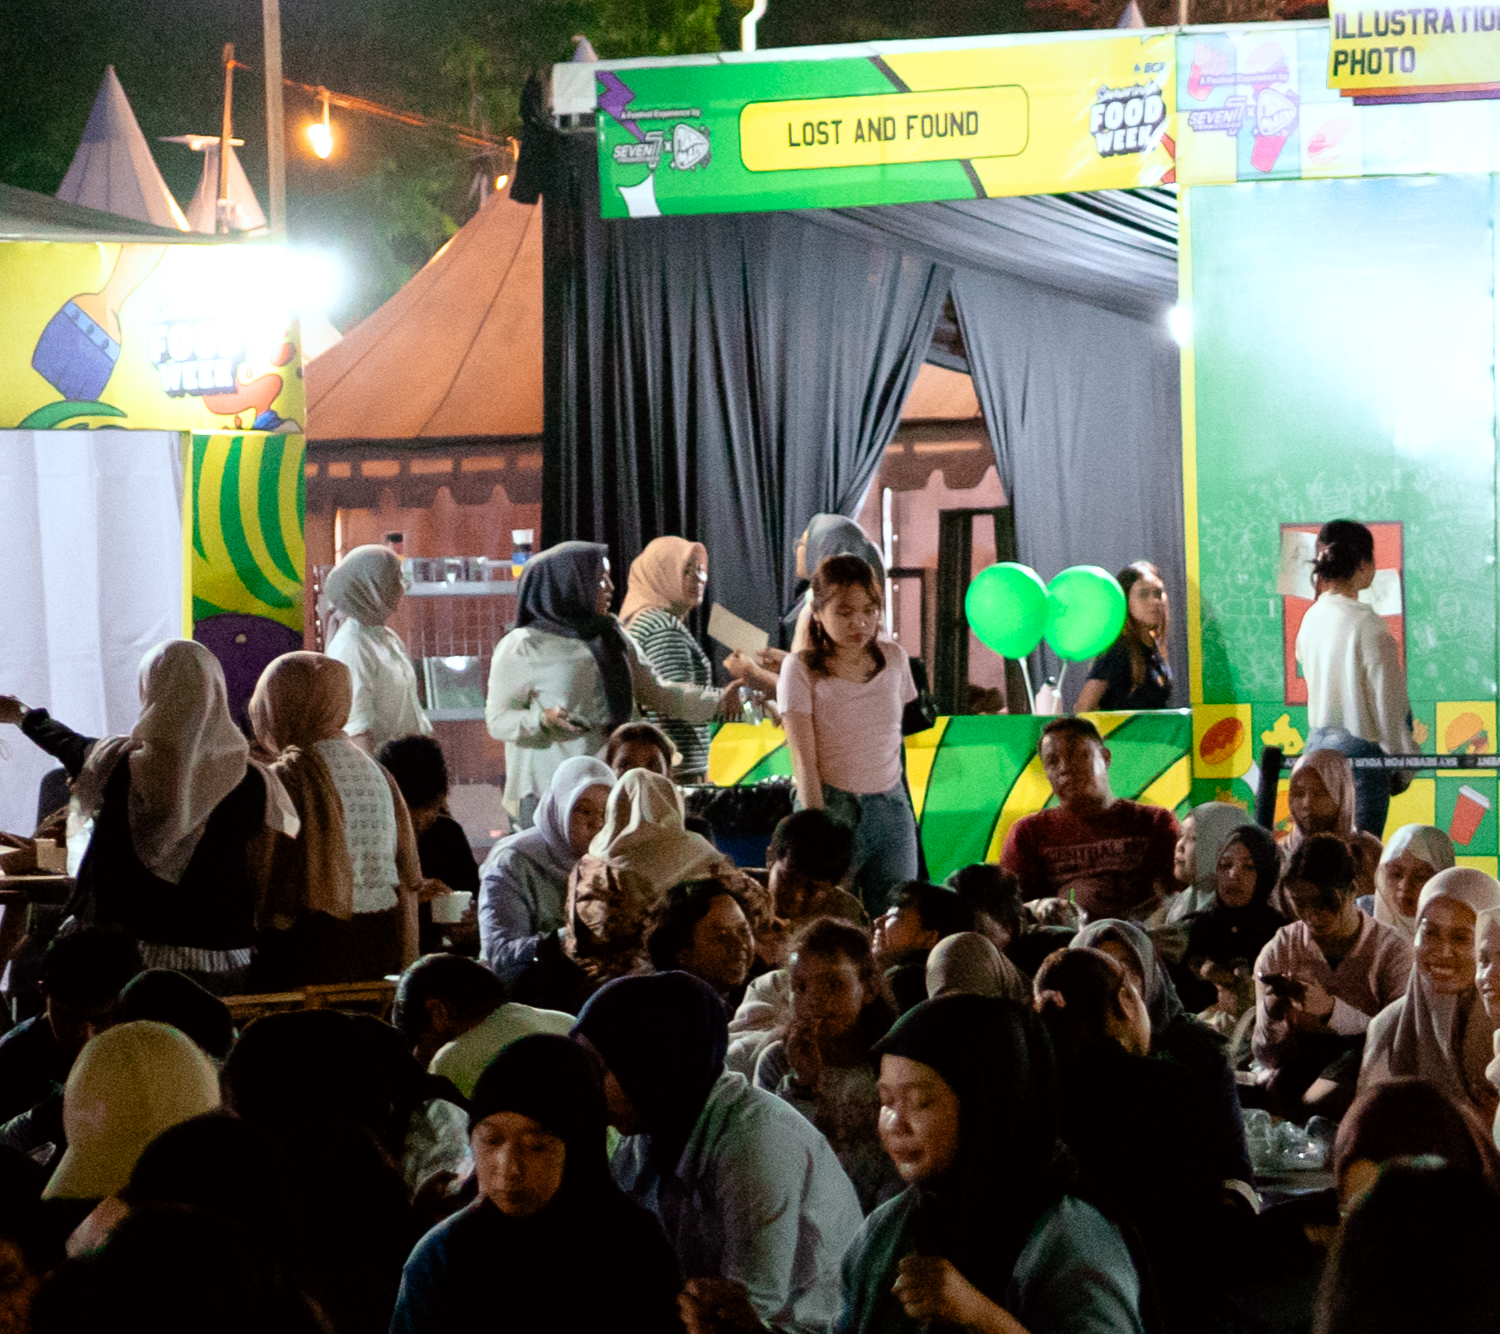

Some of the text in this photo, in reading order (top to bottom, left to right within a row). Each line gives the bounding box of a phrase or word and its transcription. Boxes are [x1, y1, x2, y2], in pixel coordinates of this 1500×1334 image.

[1333, 46, 1416, 76] PHOTO
[789, 110, 979, 148] LOST AND FOUND
[1090, 95, 1164, 133] FOOD
[1096, 124, 1157, 153] WEEK
[158, 358, 234, 391] WEEK
